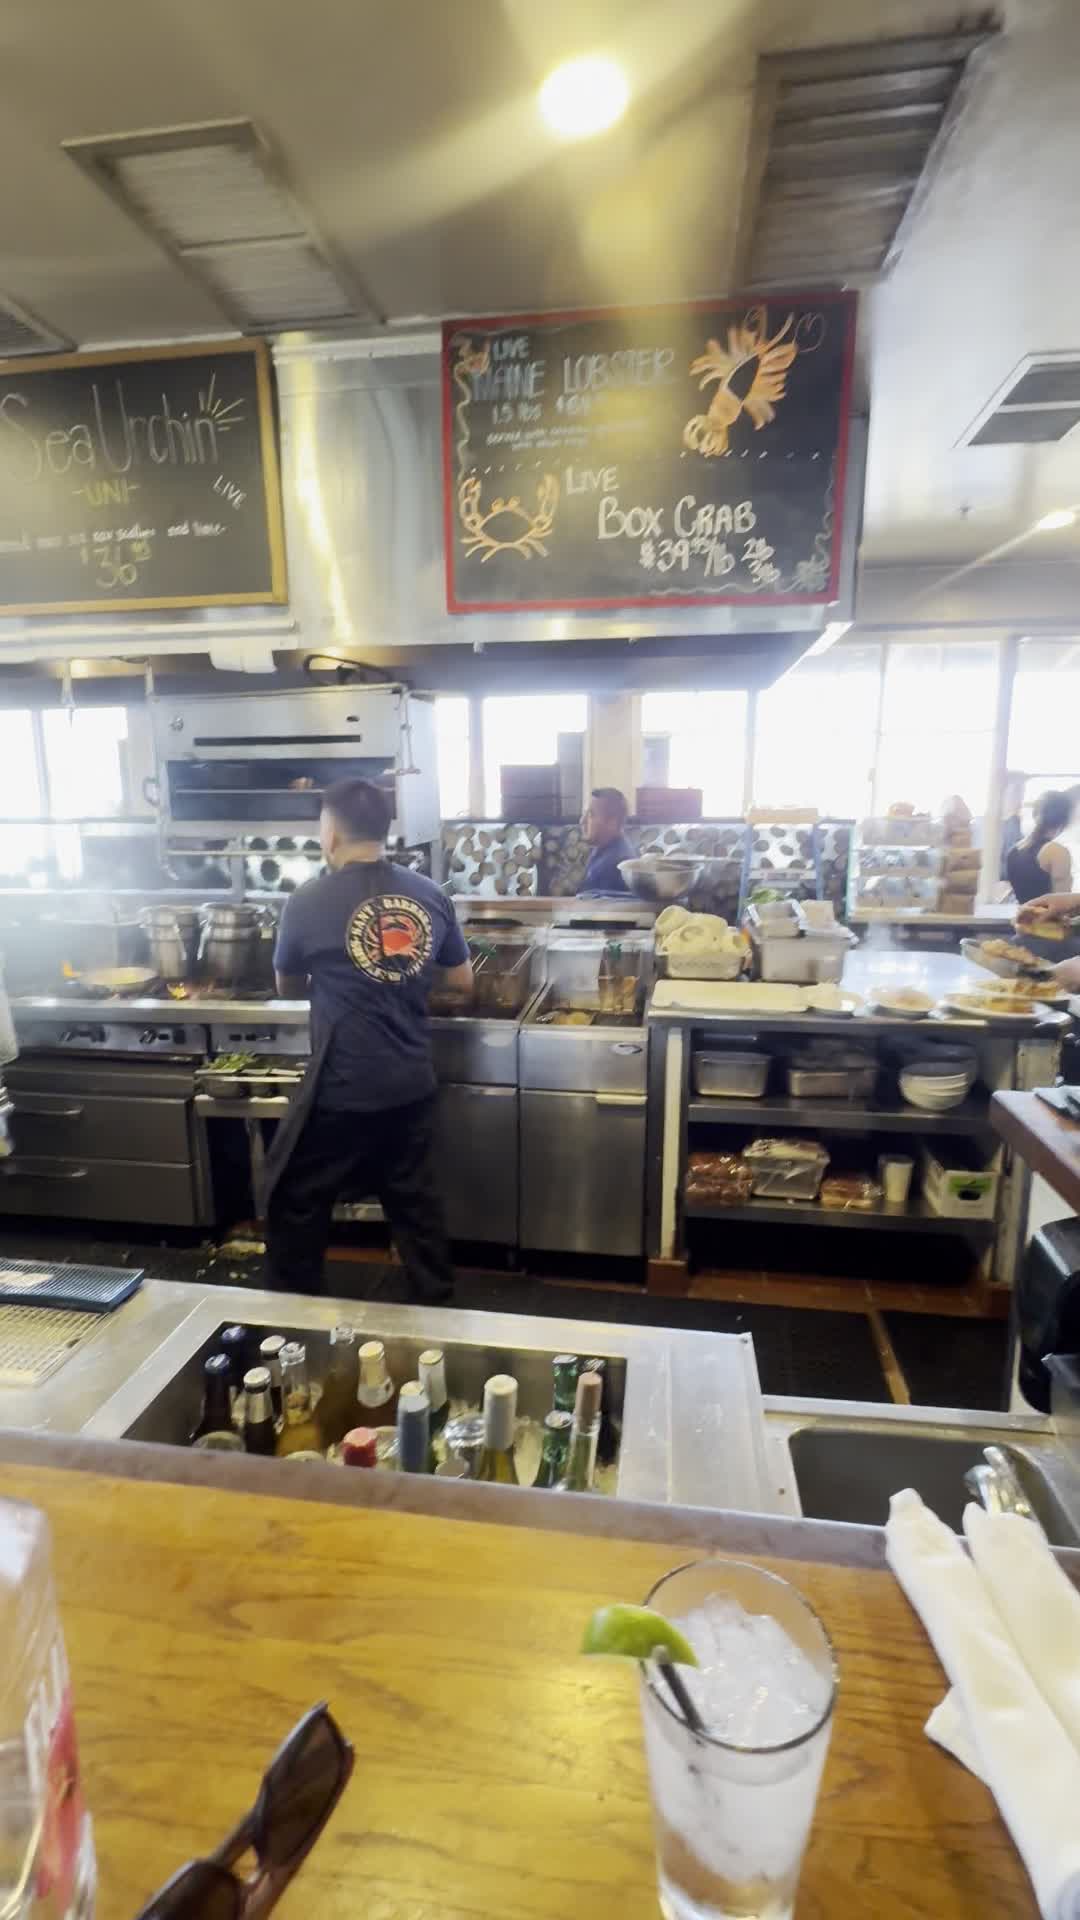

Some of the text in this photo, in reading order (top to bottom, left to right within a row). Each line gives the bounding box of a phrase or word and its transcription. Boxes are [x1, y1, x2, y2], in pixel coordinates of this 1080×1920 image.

[492, 336, 529, 361] LIVE
[563, 347, 675, 394] LOBSTER
[0, 379, 219, 480] Sea Urchin
[213, 474, 248, 511] LIVE
[565, 465, 620, 496] LIVE
